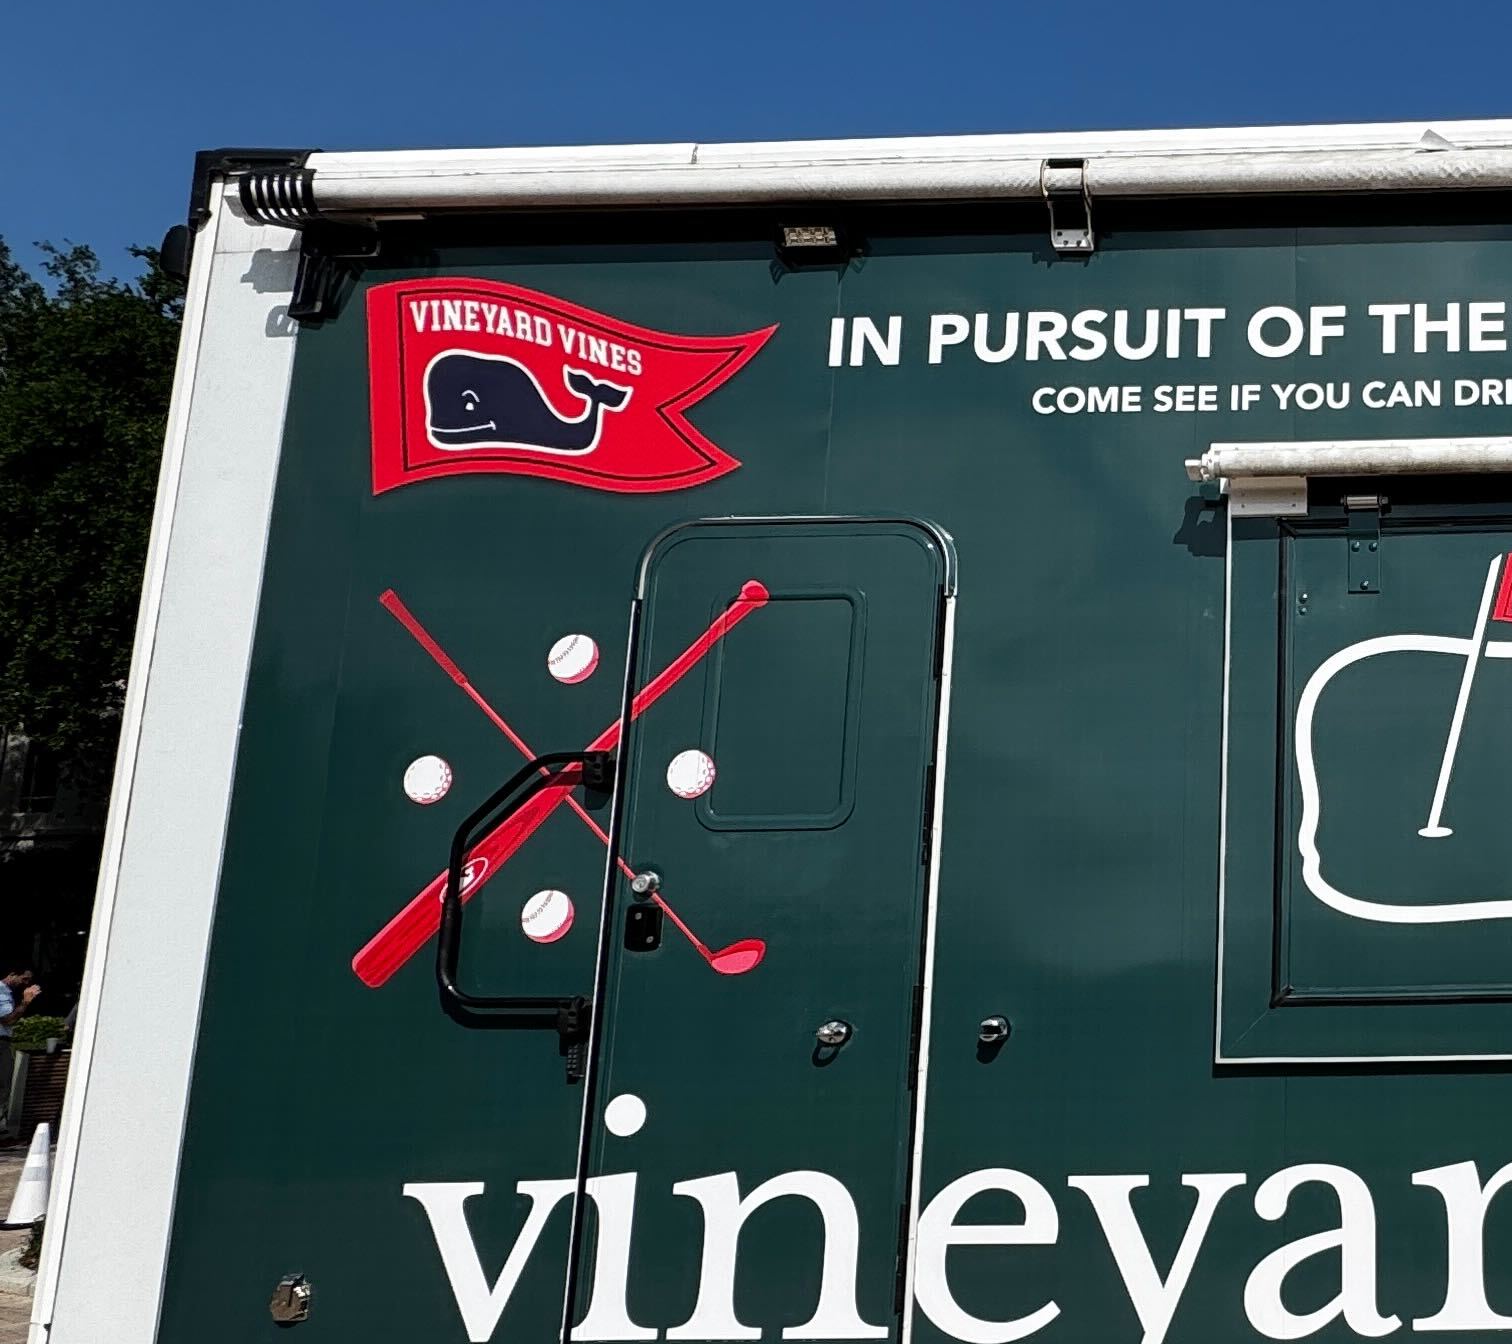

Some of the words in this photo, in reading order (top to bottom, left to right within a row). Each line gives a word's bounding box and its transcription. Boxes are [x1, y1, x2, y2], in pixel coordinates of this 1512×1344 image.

[410, 299, 553, 348] VINEYARD
[556, 323, 643, 377] VINES
[827, 315, 902, 367] IN
[928, 307, 1226, 364] PURSUIT
[1247, 305, 1347, 358] OF
[1368, 301, 1507, 354] THE
[1032, 386, 1143, 415] COME
[1153, 384, 1218, 413] SEE
[1230, 384, 1261, 411] IF
[1270, 382, 1350, 410] YOU
[1362, 379, 1441, 409] CAN
